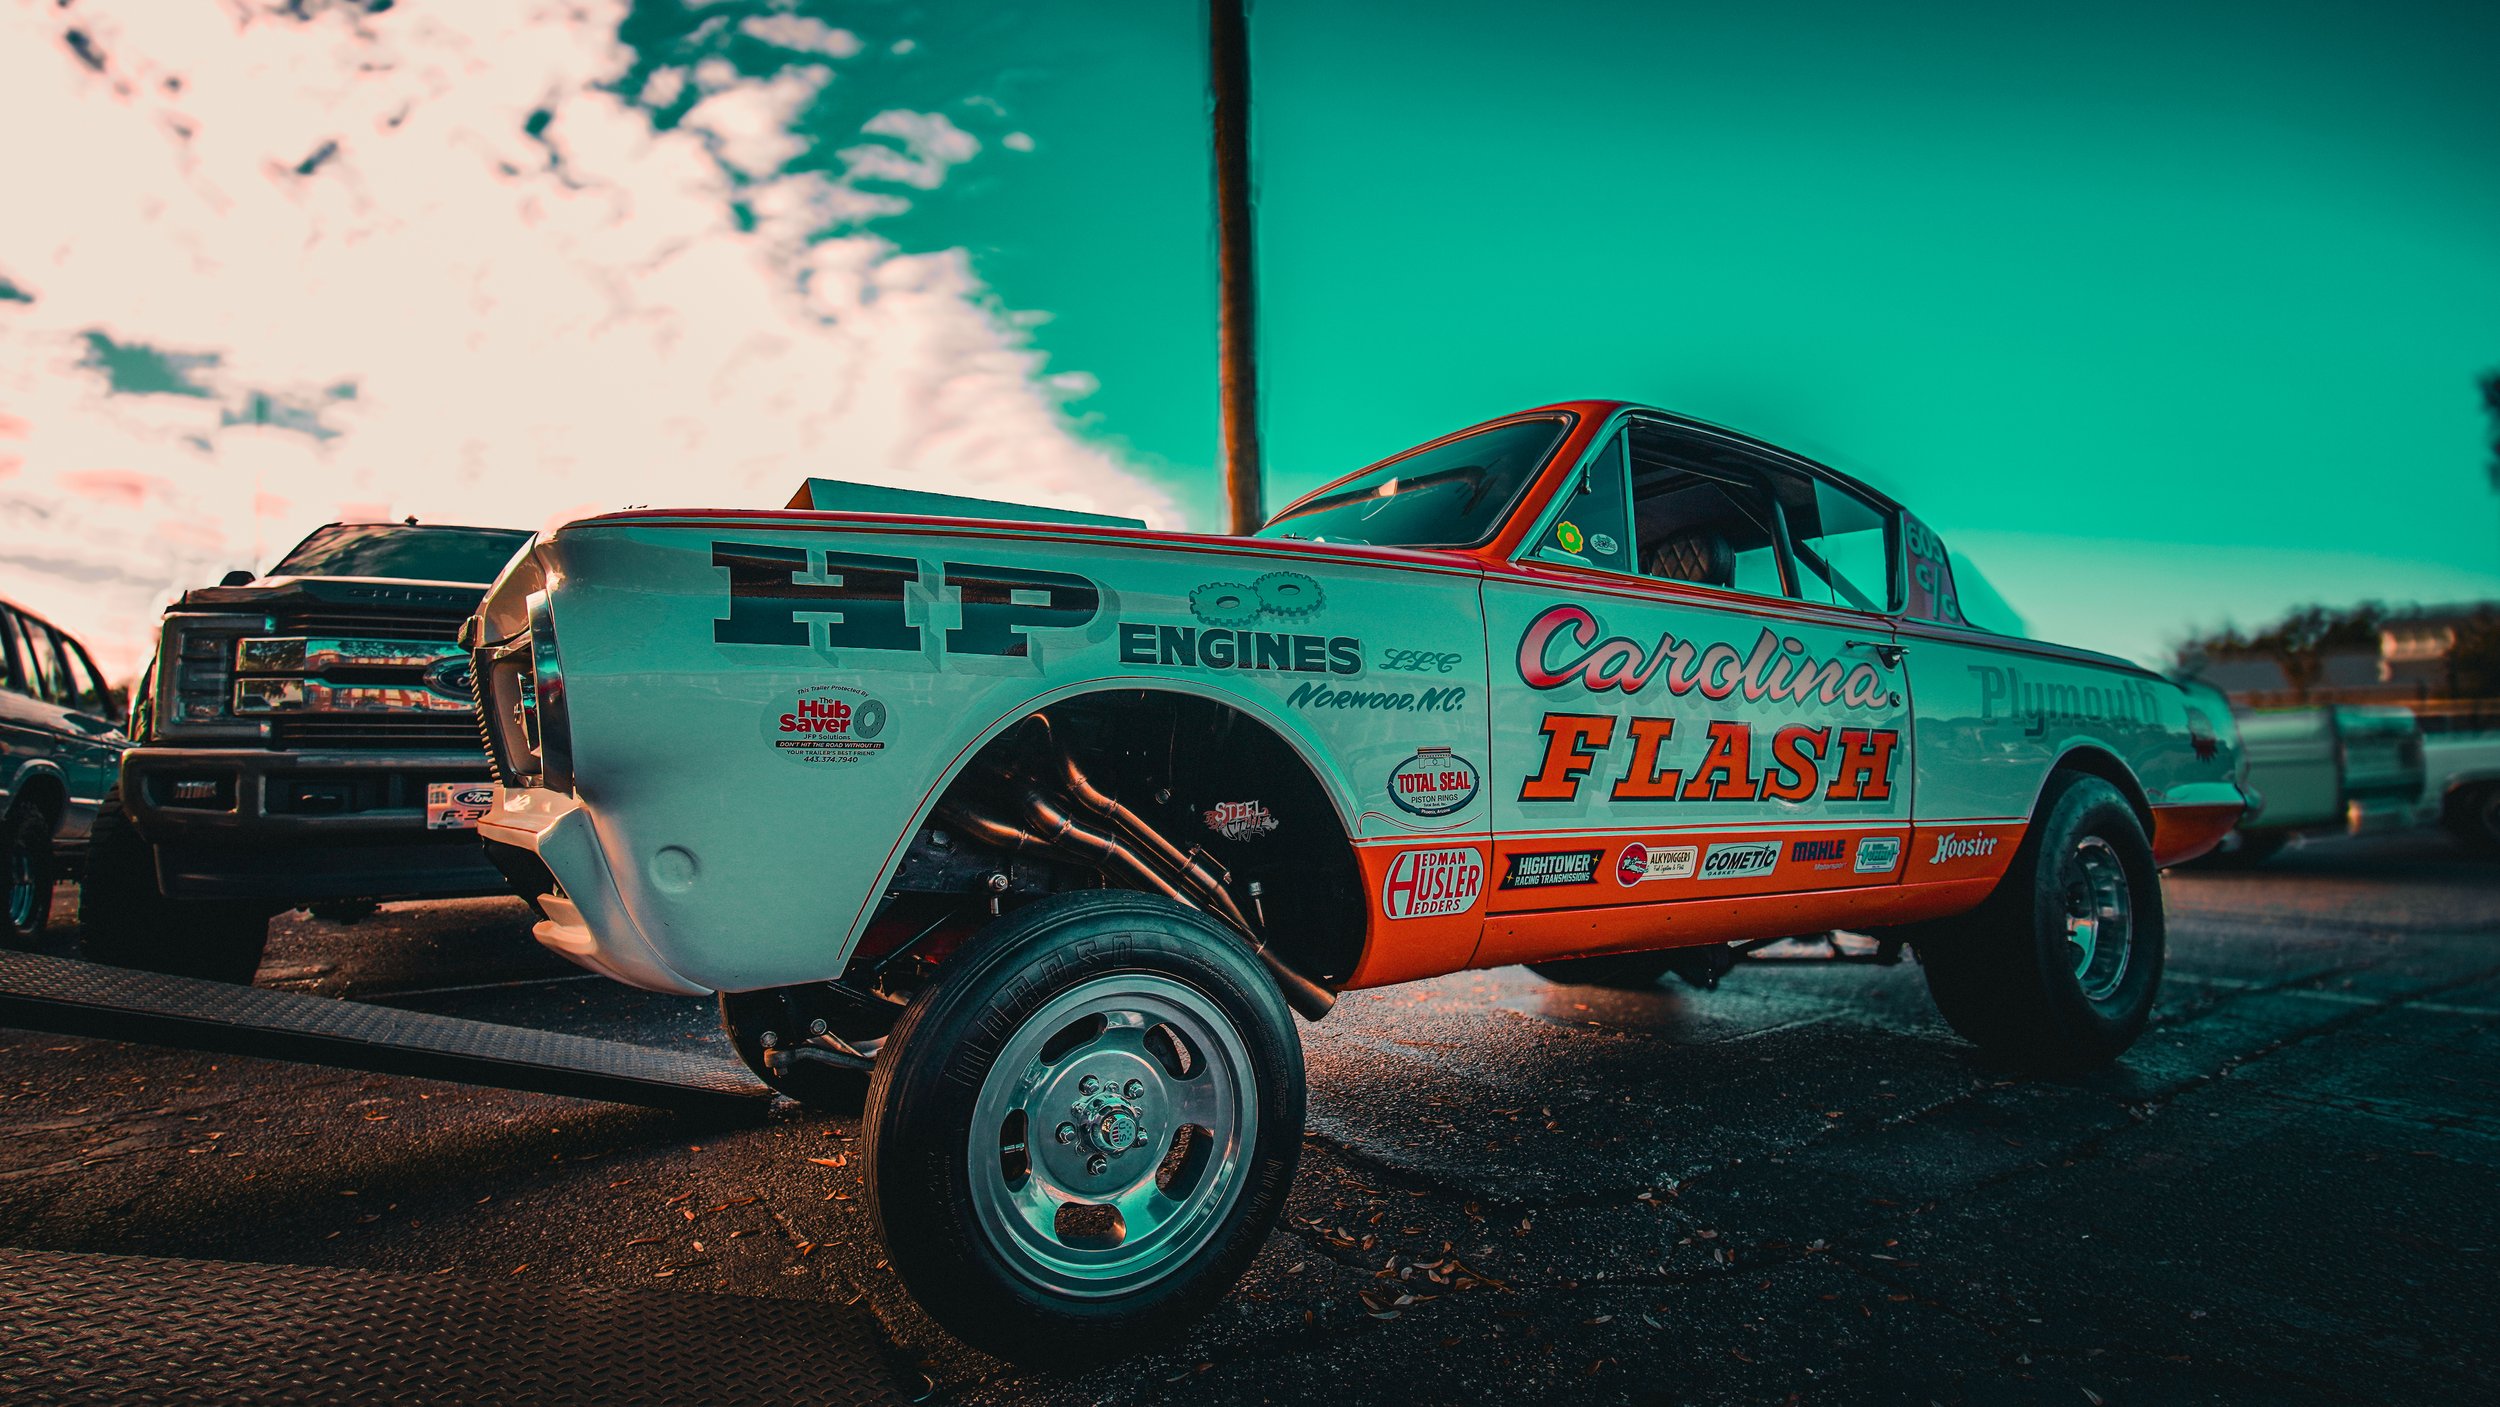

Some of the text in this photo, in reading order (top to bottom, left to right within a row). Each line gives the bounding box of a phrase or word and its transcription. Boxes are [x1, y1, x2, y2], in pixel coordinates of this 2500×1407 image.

[711, 540, 1102, 658] HP
[1118, 622, 1363, 675] ENGINES
[1515, 602, 1896, 709] Carolina
[831, 685, 860, 694] Protected
[1416, 686, 1466, 713] N.C.
[1967, 664, 2161, 738] Plymouth
[798, 699, 852, 719] Hub
[779, 713, 852, 733] Saver
[1516, 711, 1900, 804] FLASH
[1397, 770, 1472, 794] TOTAL SEAL
[1411, 793, 1459, 804] PISTON RINGS
[1215, 799, 1265, 822] STEEL
[1791, 839, 1846, 862] MAHLE
[1928, 831, 1998, 865] Hoosier
[1518, 854, 1591, 875] HIGHTOWER
[1705, 849, 1777, 871] COMETIC
[1514, 871, 1591, 886] RACING TRANSMISSIONS
[1707, 869, 1736, 877] GASKET
